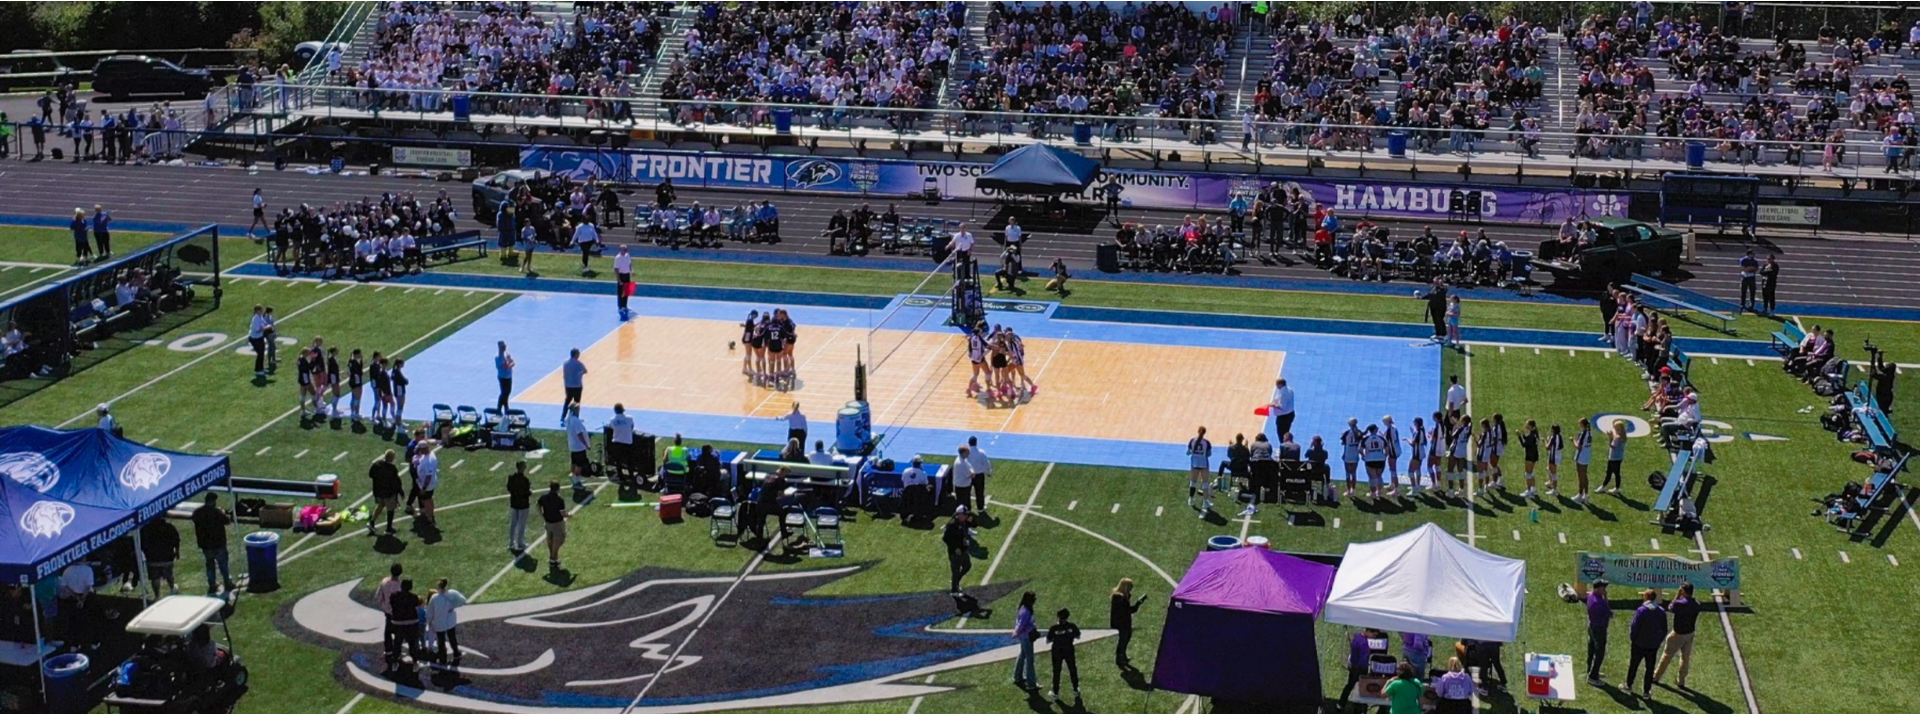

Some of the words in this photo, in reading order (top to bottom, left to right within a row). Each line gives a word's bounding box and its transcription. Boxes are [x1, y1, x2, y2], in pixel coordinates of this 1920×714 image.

[630, 154, 772, 184] FRONTIER
[916, 164, 955, 177] TWO
[1093, 171, 1190, 189] OMMUNITY.
[1334, 184, 1497, 217] HAMBUG
[771, 330, 784, 340] 12
[137, 489, 184, 523] FRONTIER
[185, 464, 226, 496] FALCONS
[36, 540, 90, 580] FRONTIER
[90, 518, 136, 547] FALCONS
[1613, 558, 1654, 569] FRONTIER
[1655, 559, 1701, 572] VOLLEYBALL
[1626, 572, 1666, 583] STADIUM
[1667, 574, 1688, 584] GAME
